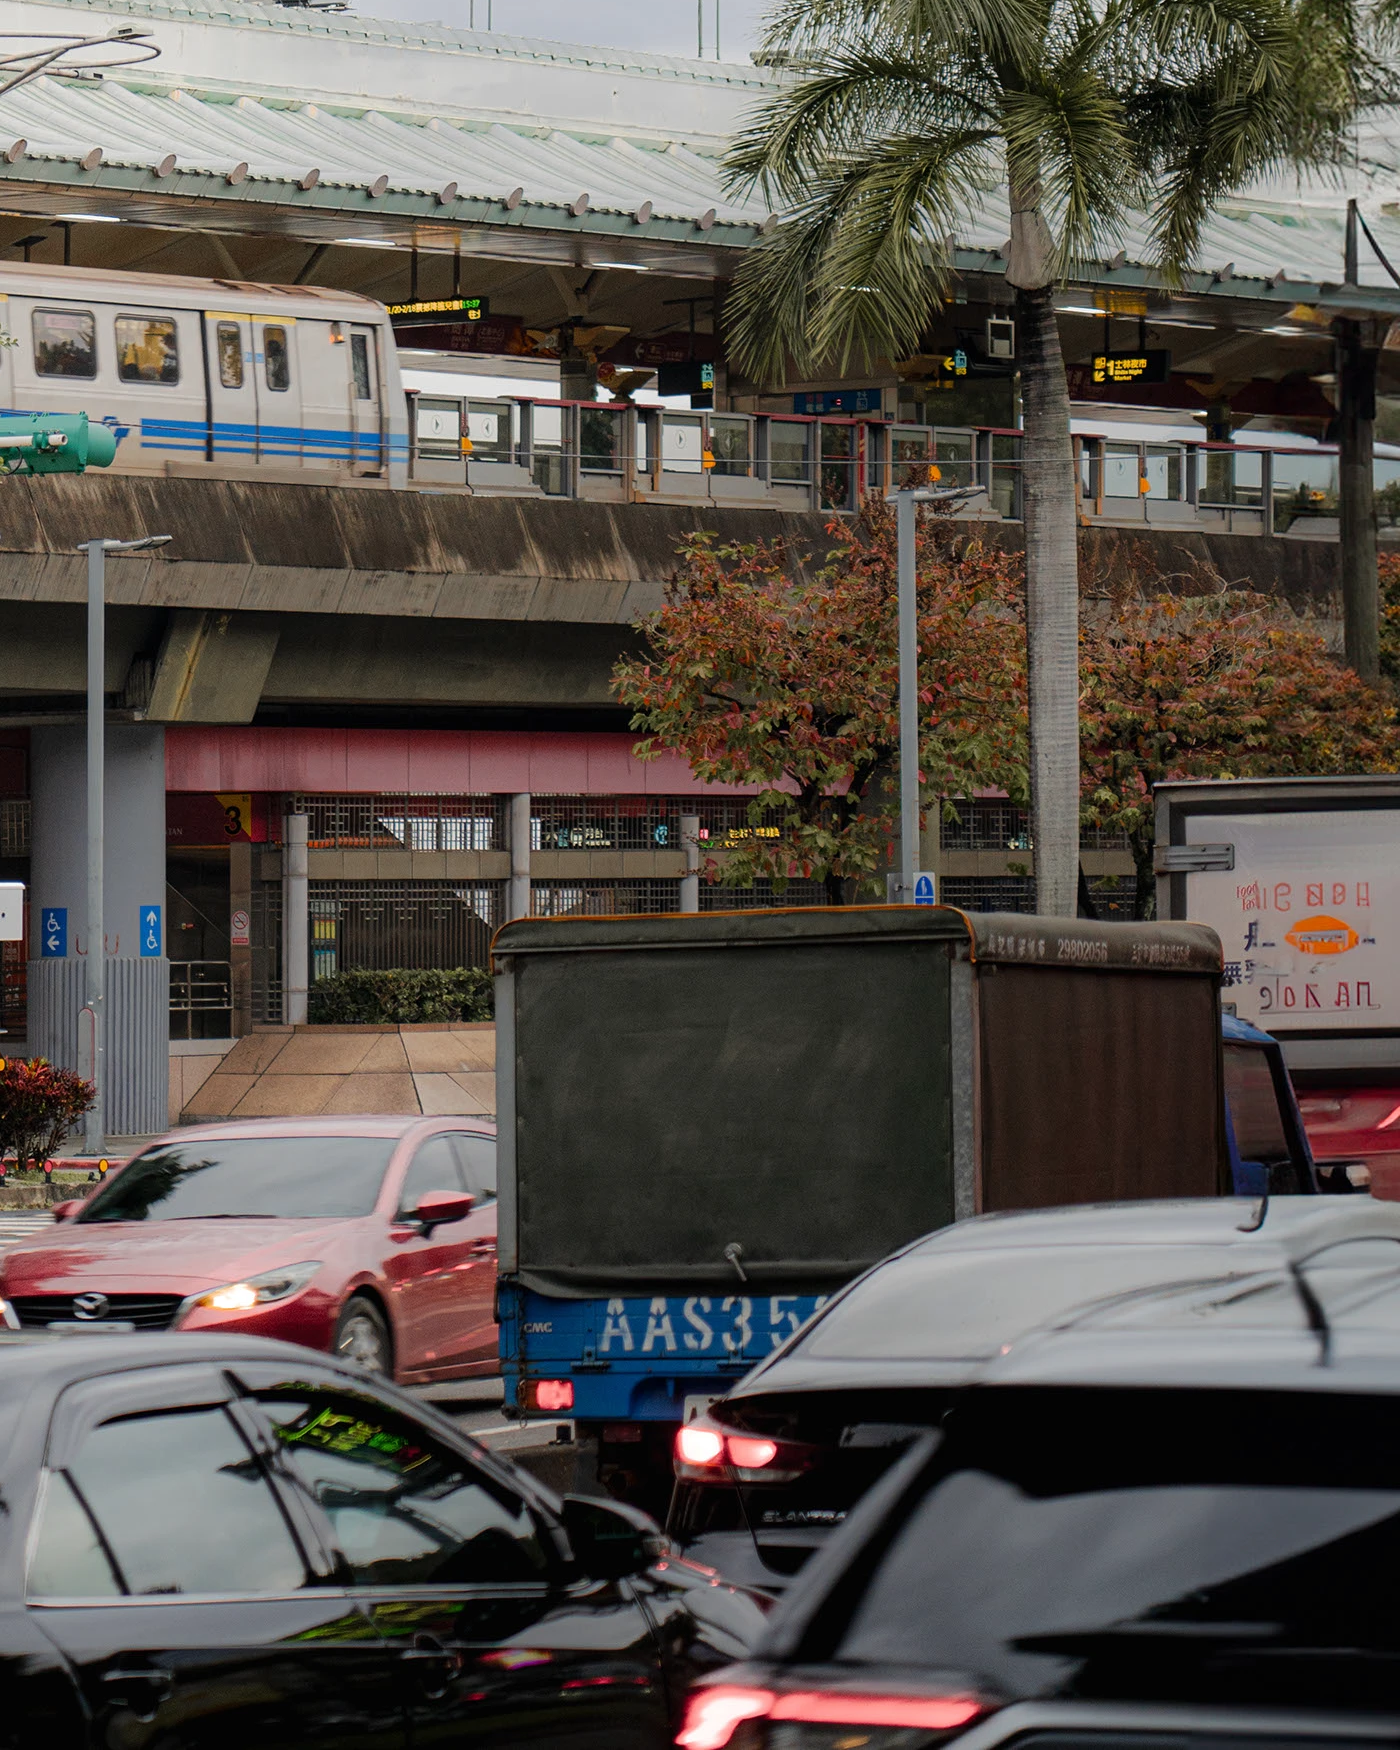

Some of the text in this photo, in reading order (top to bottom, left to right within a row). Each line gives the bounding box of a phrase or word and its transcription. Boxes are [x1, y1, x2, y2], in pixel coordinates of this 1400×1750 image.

[1107, 358, 1147, 376] 1 士林夜市
[224, 805, 242, 835] 3
[523, 1322, 552, 1333] CMC
